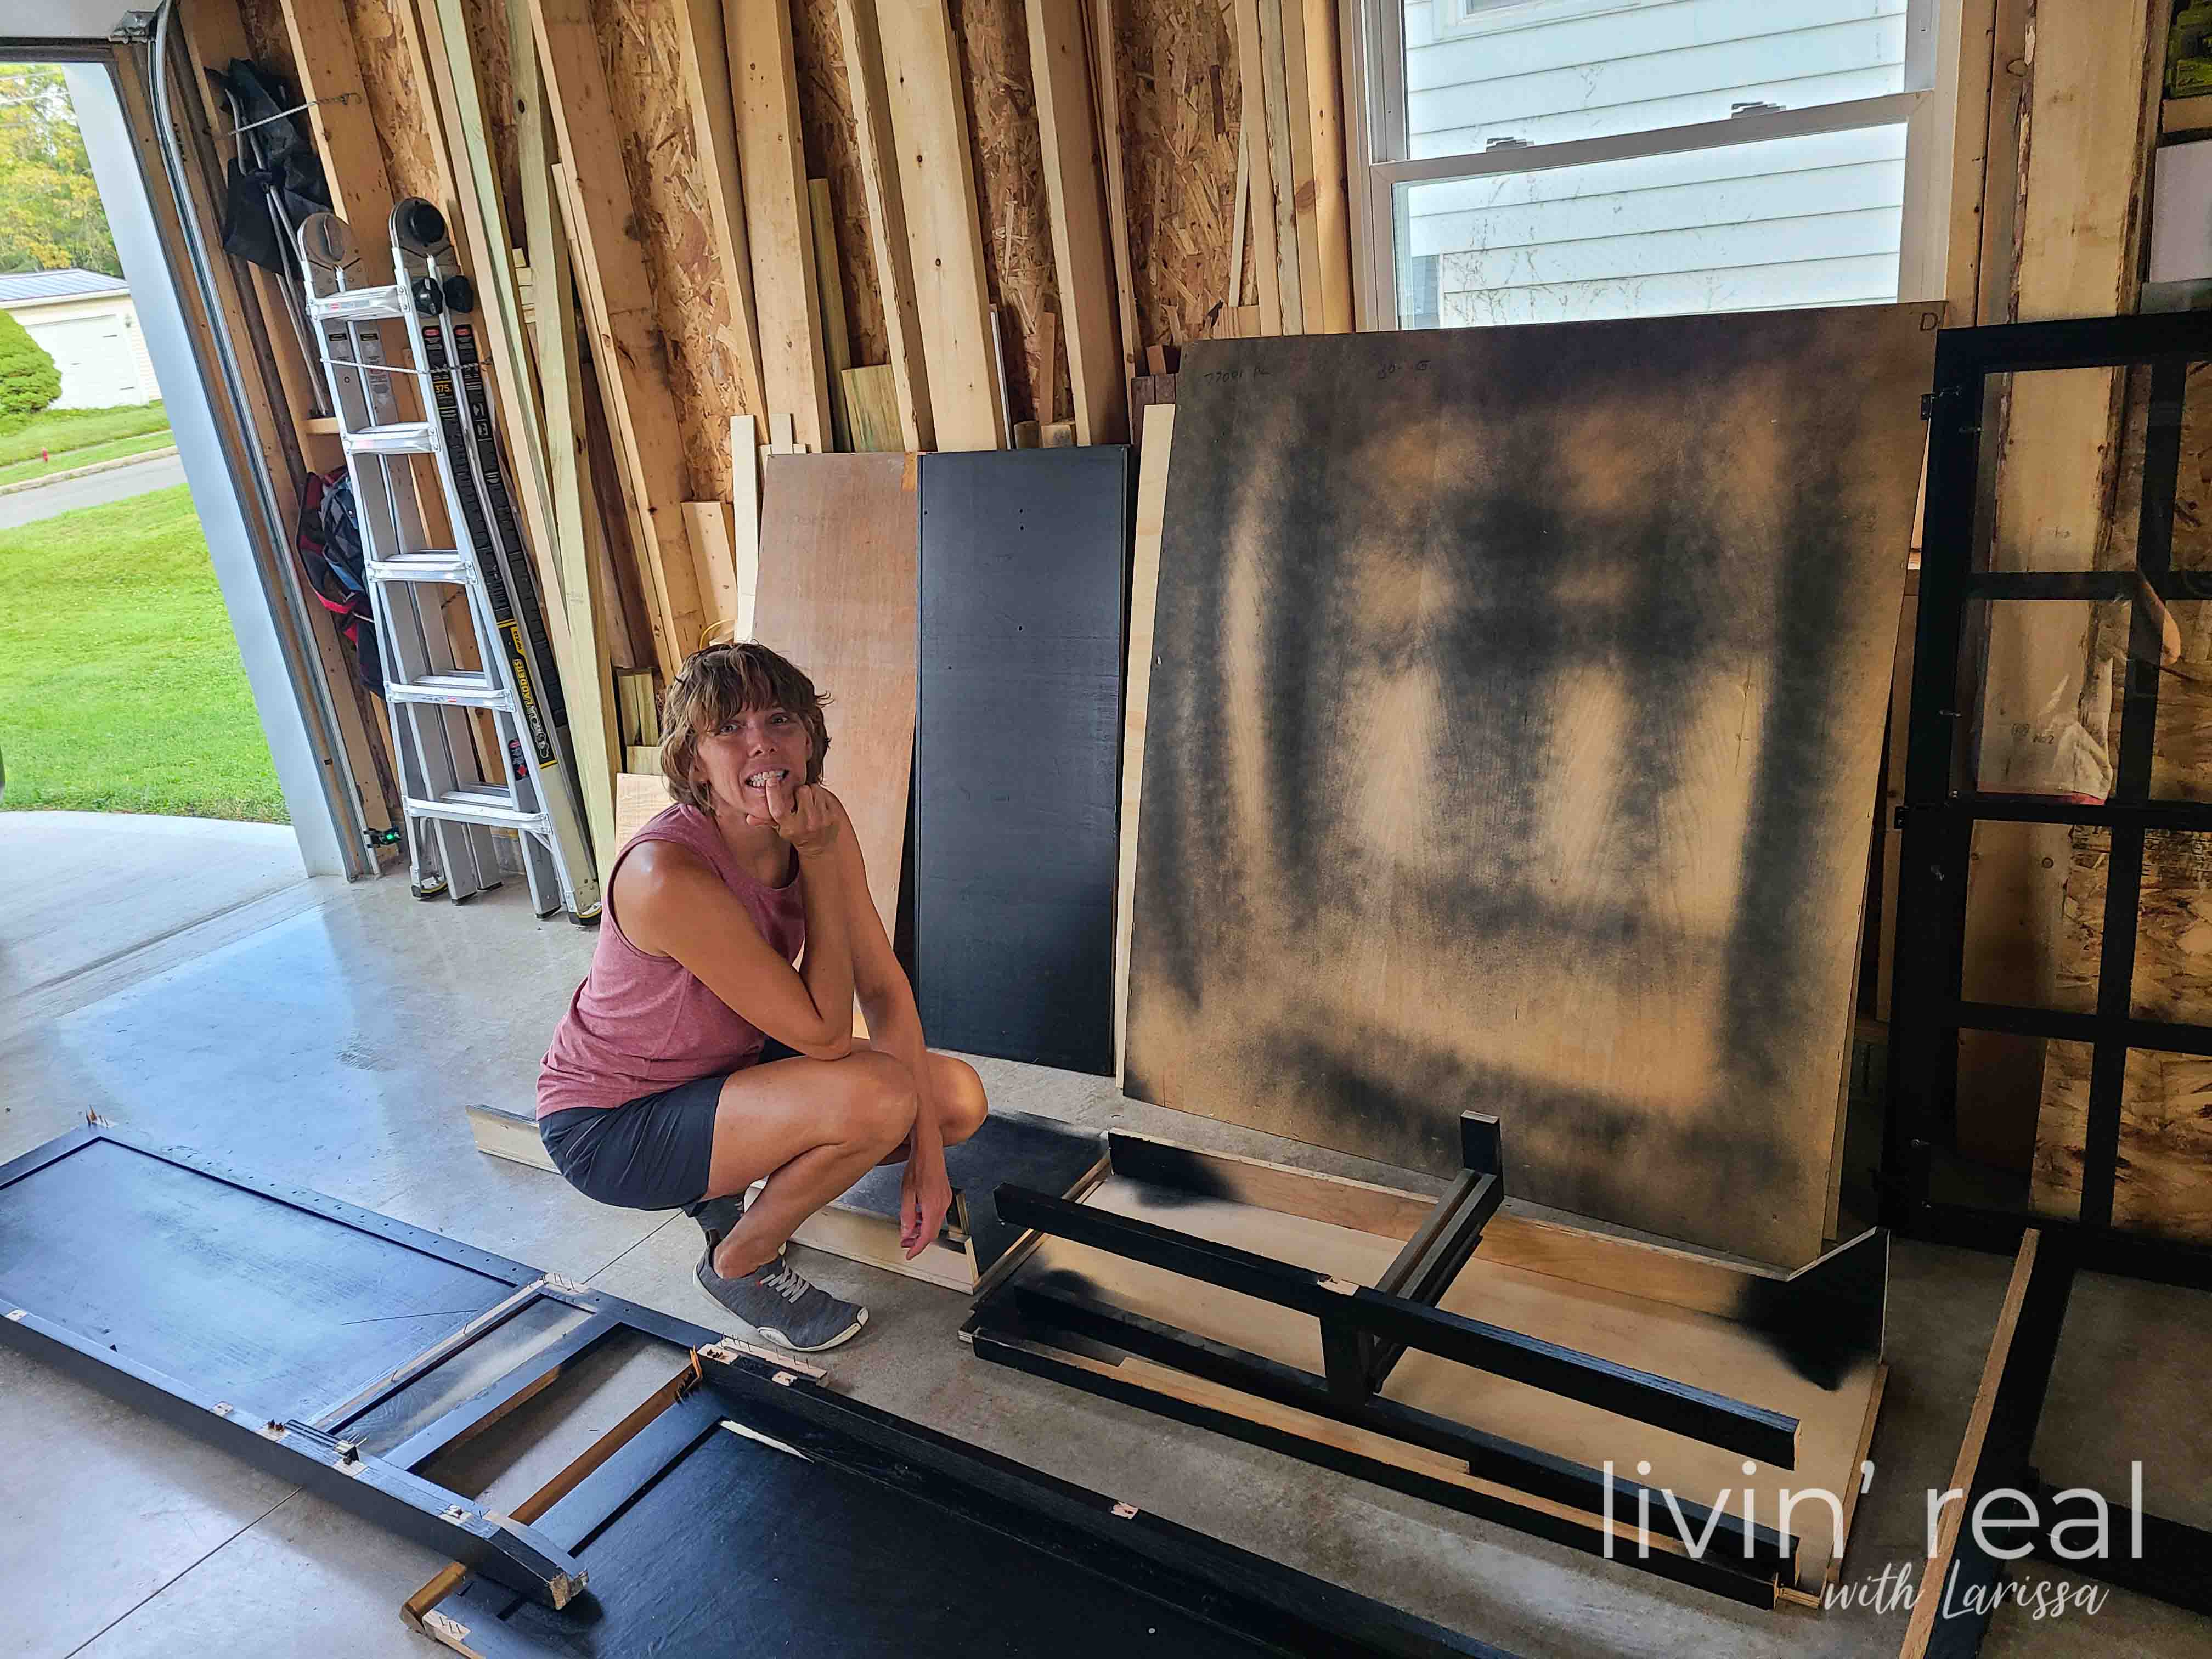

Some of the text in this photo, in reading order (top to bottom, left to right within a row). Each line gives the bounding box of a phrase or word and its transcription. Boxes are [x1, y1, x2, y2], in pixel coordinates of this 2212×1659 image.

[1920, 312, 1938, 331] D
[435, 385, 449, 393] 375
[514, 659, 534, 706] LADDERS
